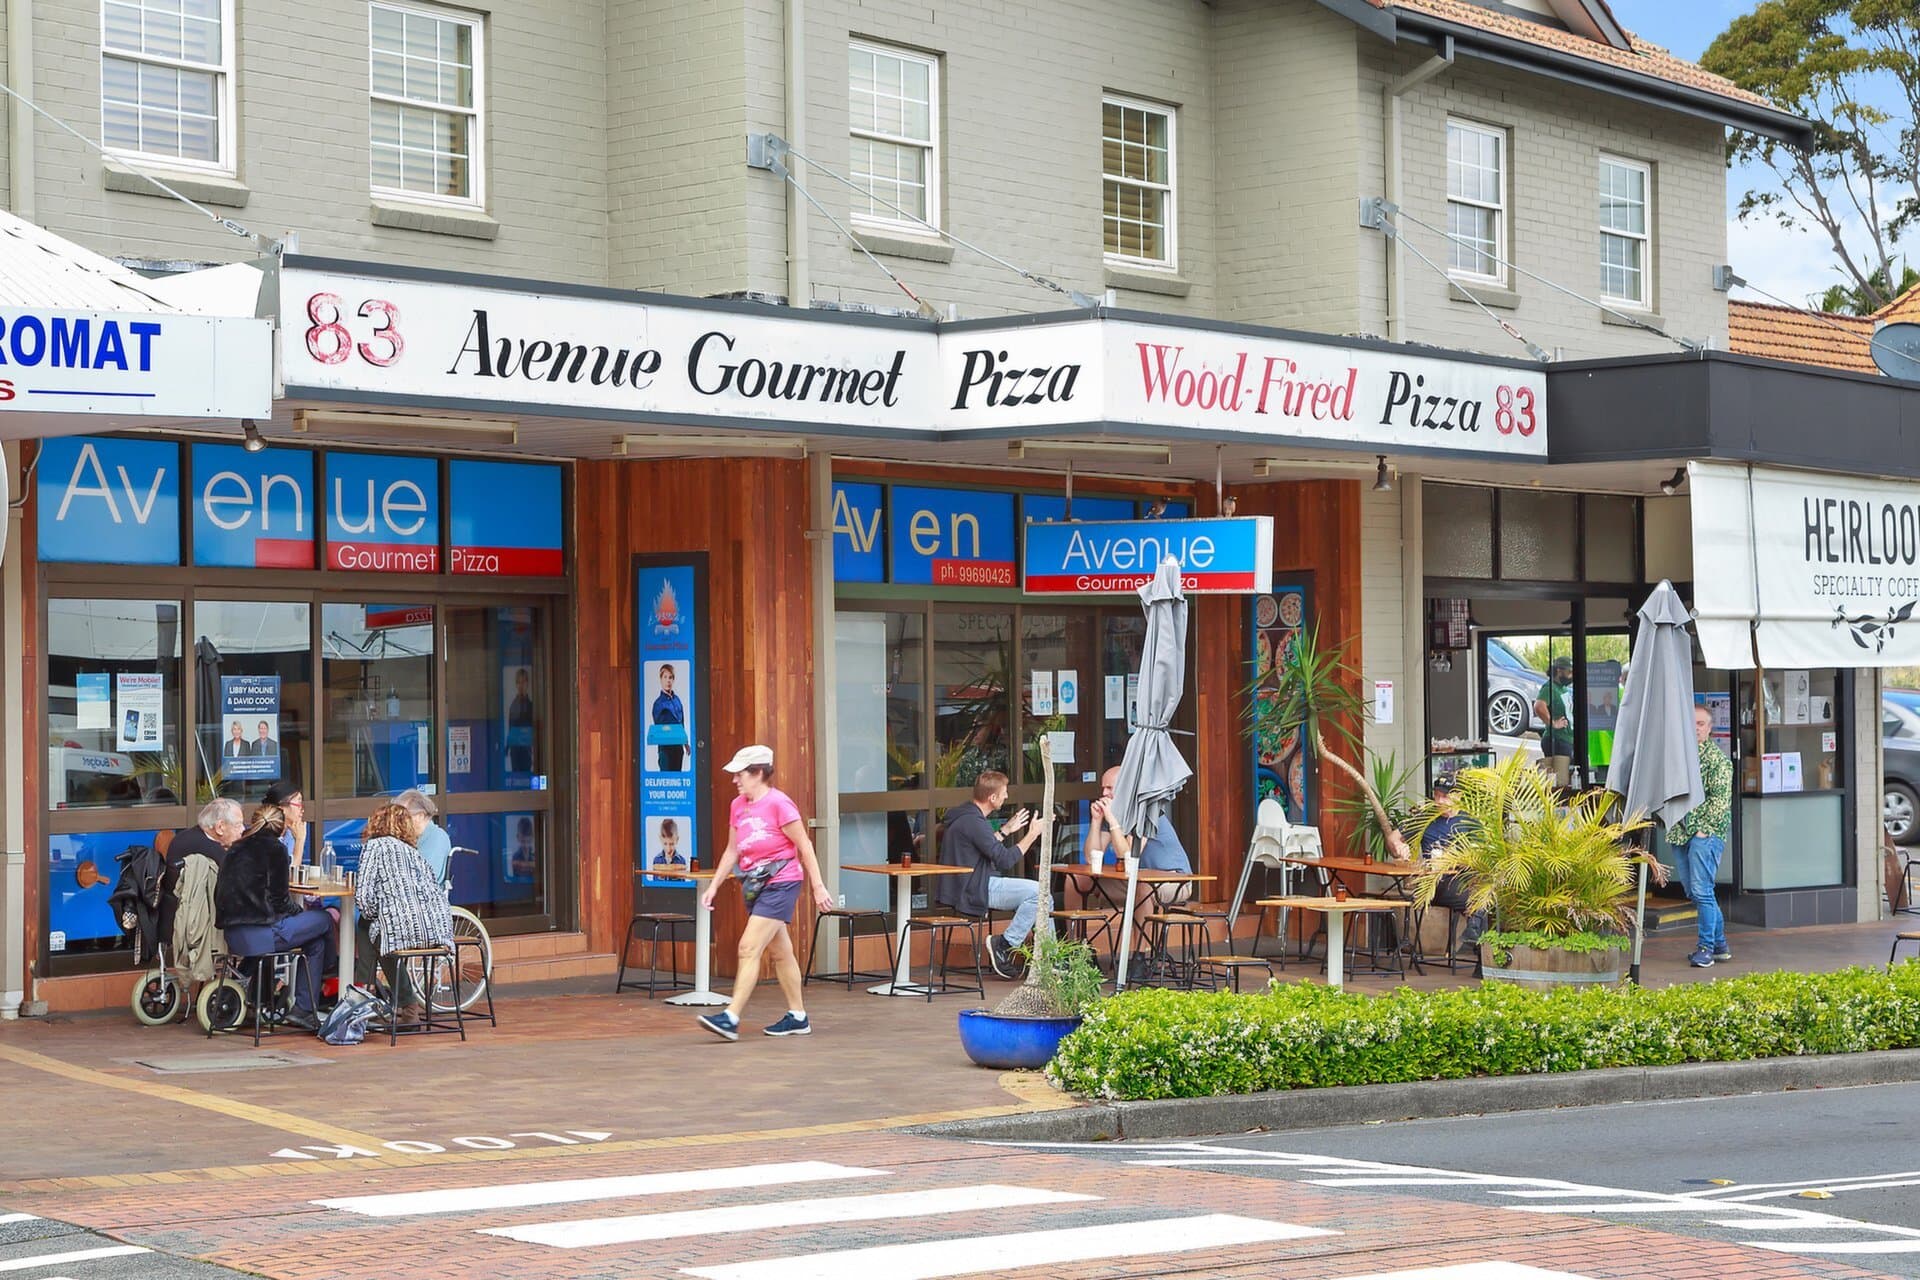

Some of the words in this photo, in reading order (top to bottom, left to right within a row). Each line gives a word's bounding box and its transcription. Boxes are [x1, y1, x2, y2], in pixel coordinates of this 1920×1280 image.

[0, 314, 161, 372] OMAT
[306, 292, 404, 368] 83
[446, 310, 662, 388] Avenue
[687, 332, 906, 408] Gourmet
[951, 350, 1081, 410] Pizza
[1137, 342, 1358, 420] Wood-Fired
[1380, 370, 1482, 433] Pizza
[1495, 385, 1537, 437] 83
[1804, 497, 1920, 565] HEIRLOO
[337, 545, 436, 571] Gourmet
[451, 549, 499, 573] Pizza
[1061, 530, 1215, 570] Avenue
[959, 566, 1011, 584] 99690425
[1813, 574, 1883, 597] SPECIALTY
[233, 697, 254, 705] DAVID
[255, 697, 276, 705] COOK
[644, 778, 682, 787] DELIVERING
[682, 778, 691, 786] TO
[649, 790, 666, 800] YOUR
[666, 790, 687, 800] DOOR!
[302, 1131, 580, 1158] LOOK
